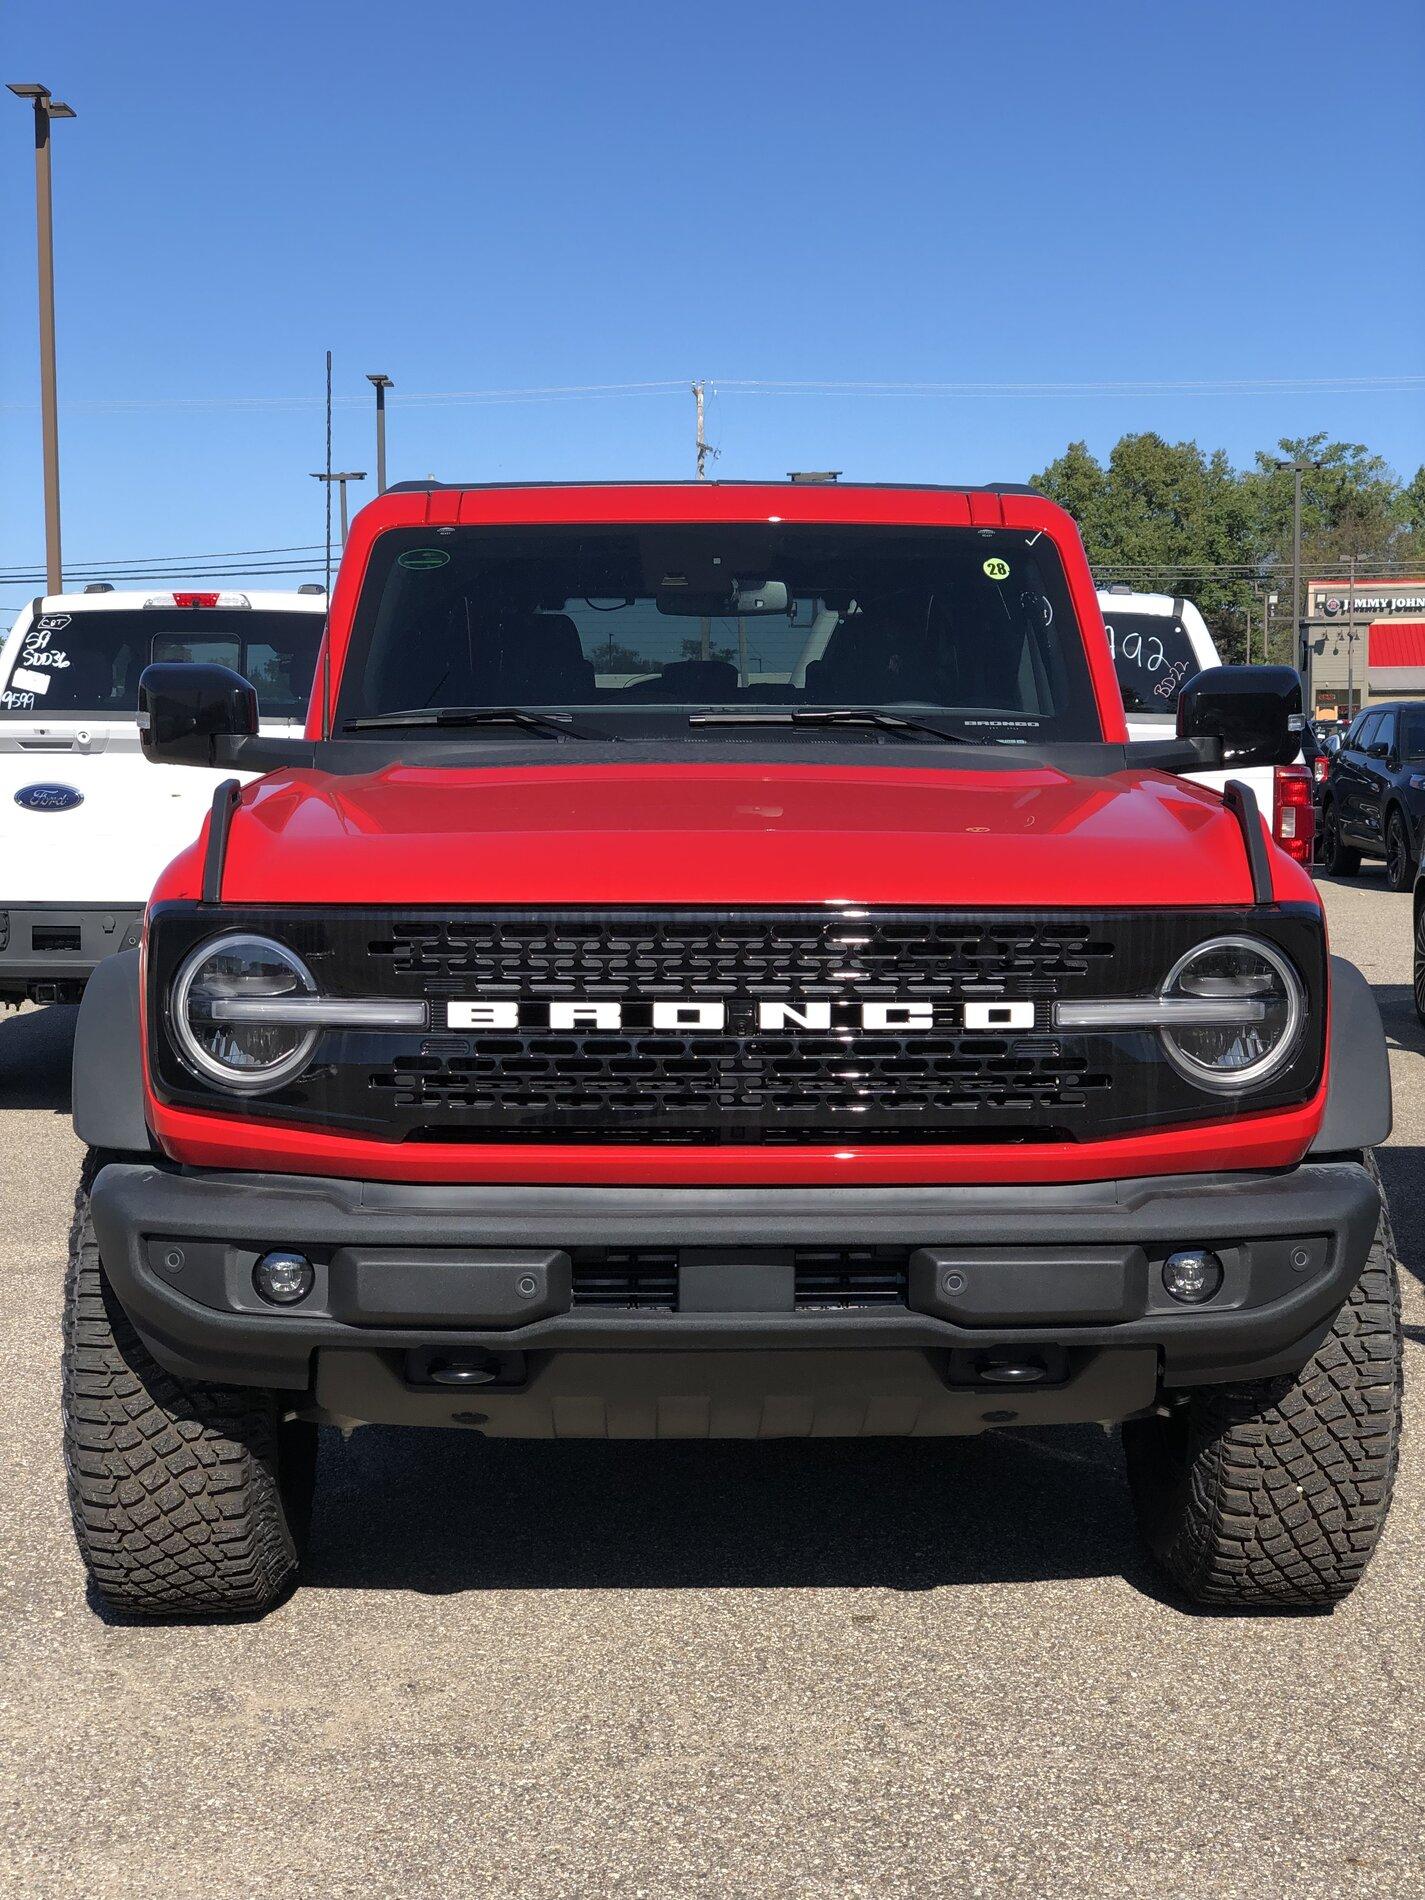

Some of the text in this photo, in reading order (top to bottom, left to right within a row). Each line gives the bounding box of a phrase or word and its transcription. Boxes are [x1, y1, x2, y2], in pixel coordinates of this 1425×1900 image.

[987, 562, 1007, 576] 28
[1343, 598, 1389, 611] JMMY
[29, 789, 69, 806] Ford
[447, 1001, 1035, 1029] BRONCO
